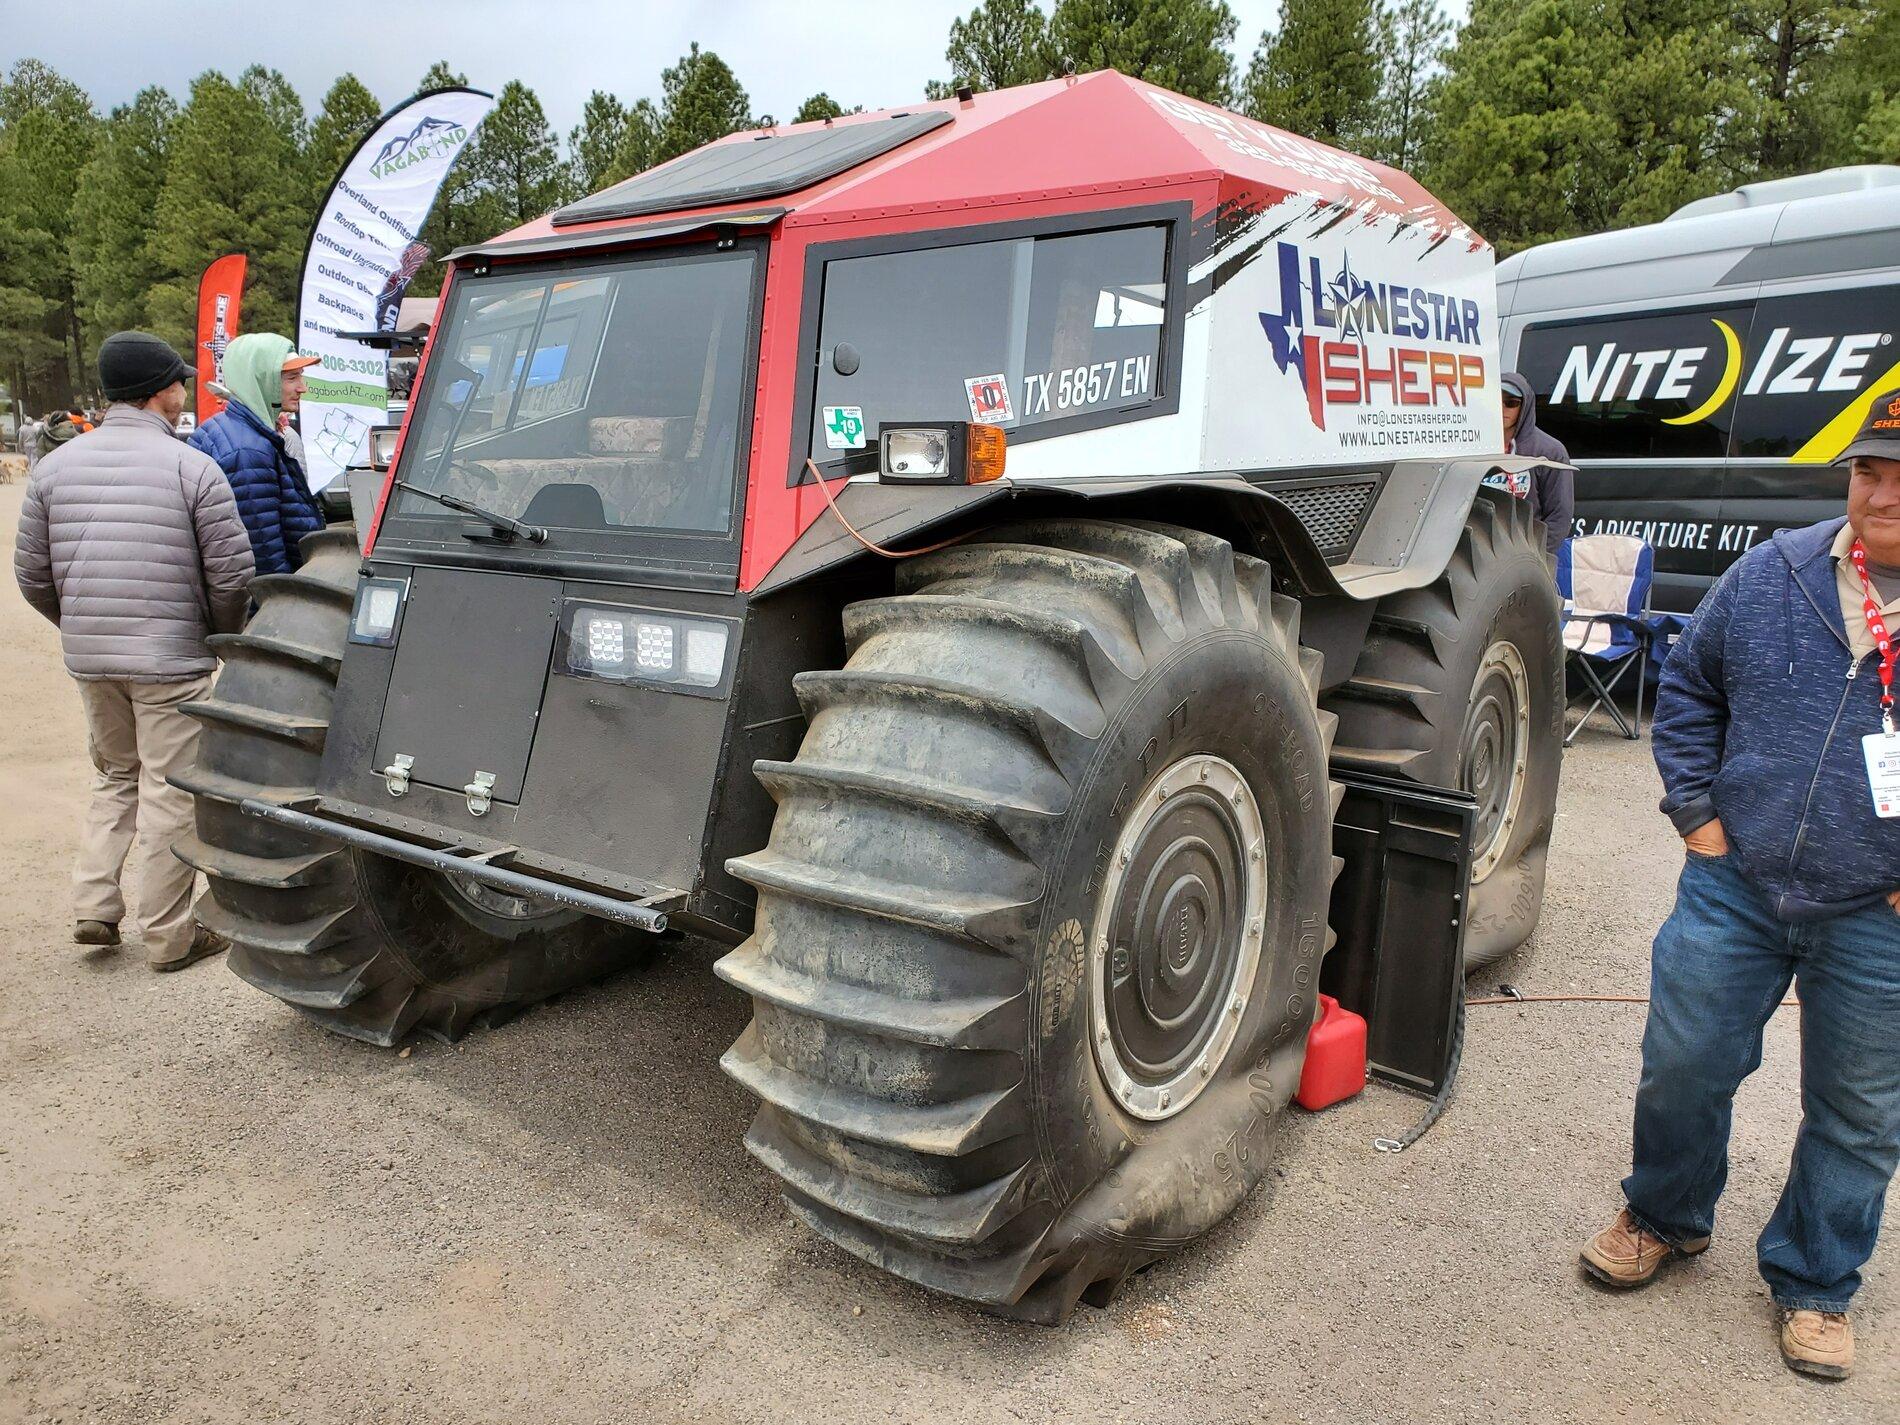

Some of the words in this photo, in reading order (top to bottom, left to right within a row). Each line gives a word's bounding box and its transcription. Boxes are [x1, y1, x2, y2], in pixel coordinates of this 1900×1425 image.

[333, 211, 365, 239] Rooftop
[338, 180, 379, 215] Overland
[379, 210, 417, 242] Outfitter
[316, 232, 353, 257] Offroad
[317, 263, 354, 288] Outdoor
[1309, 254, 1481, 346] LONESTAR
[303, 319, 318, 331] and
[1023, 372, 1054, 417] TX
[1057, 361, 1118, 410] 5857
[1120, 355, 1151, 398] EN
[1322, 340, 1485, 407] SHERP
[1549, 342, 1708, 405] NITE
[840, 419, 857, 435] 19
[1357, 410, 1467, 427] INFO@LONESTARSHERP.COM
[1338, 430, 1481, 448] WWW.LONESTARSHERP.COM
[1593, 518, 1713, 550] ADVENTURE
[1717, 524, 1759, 552] KIT
